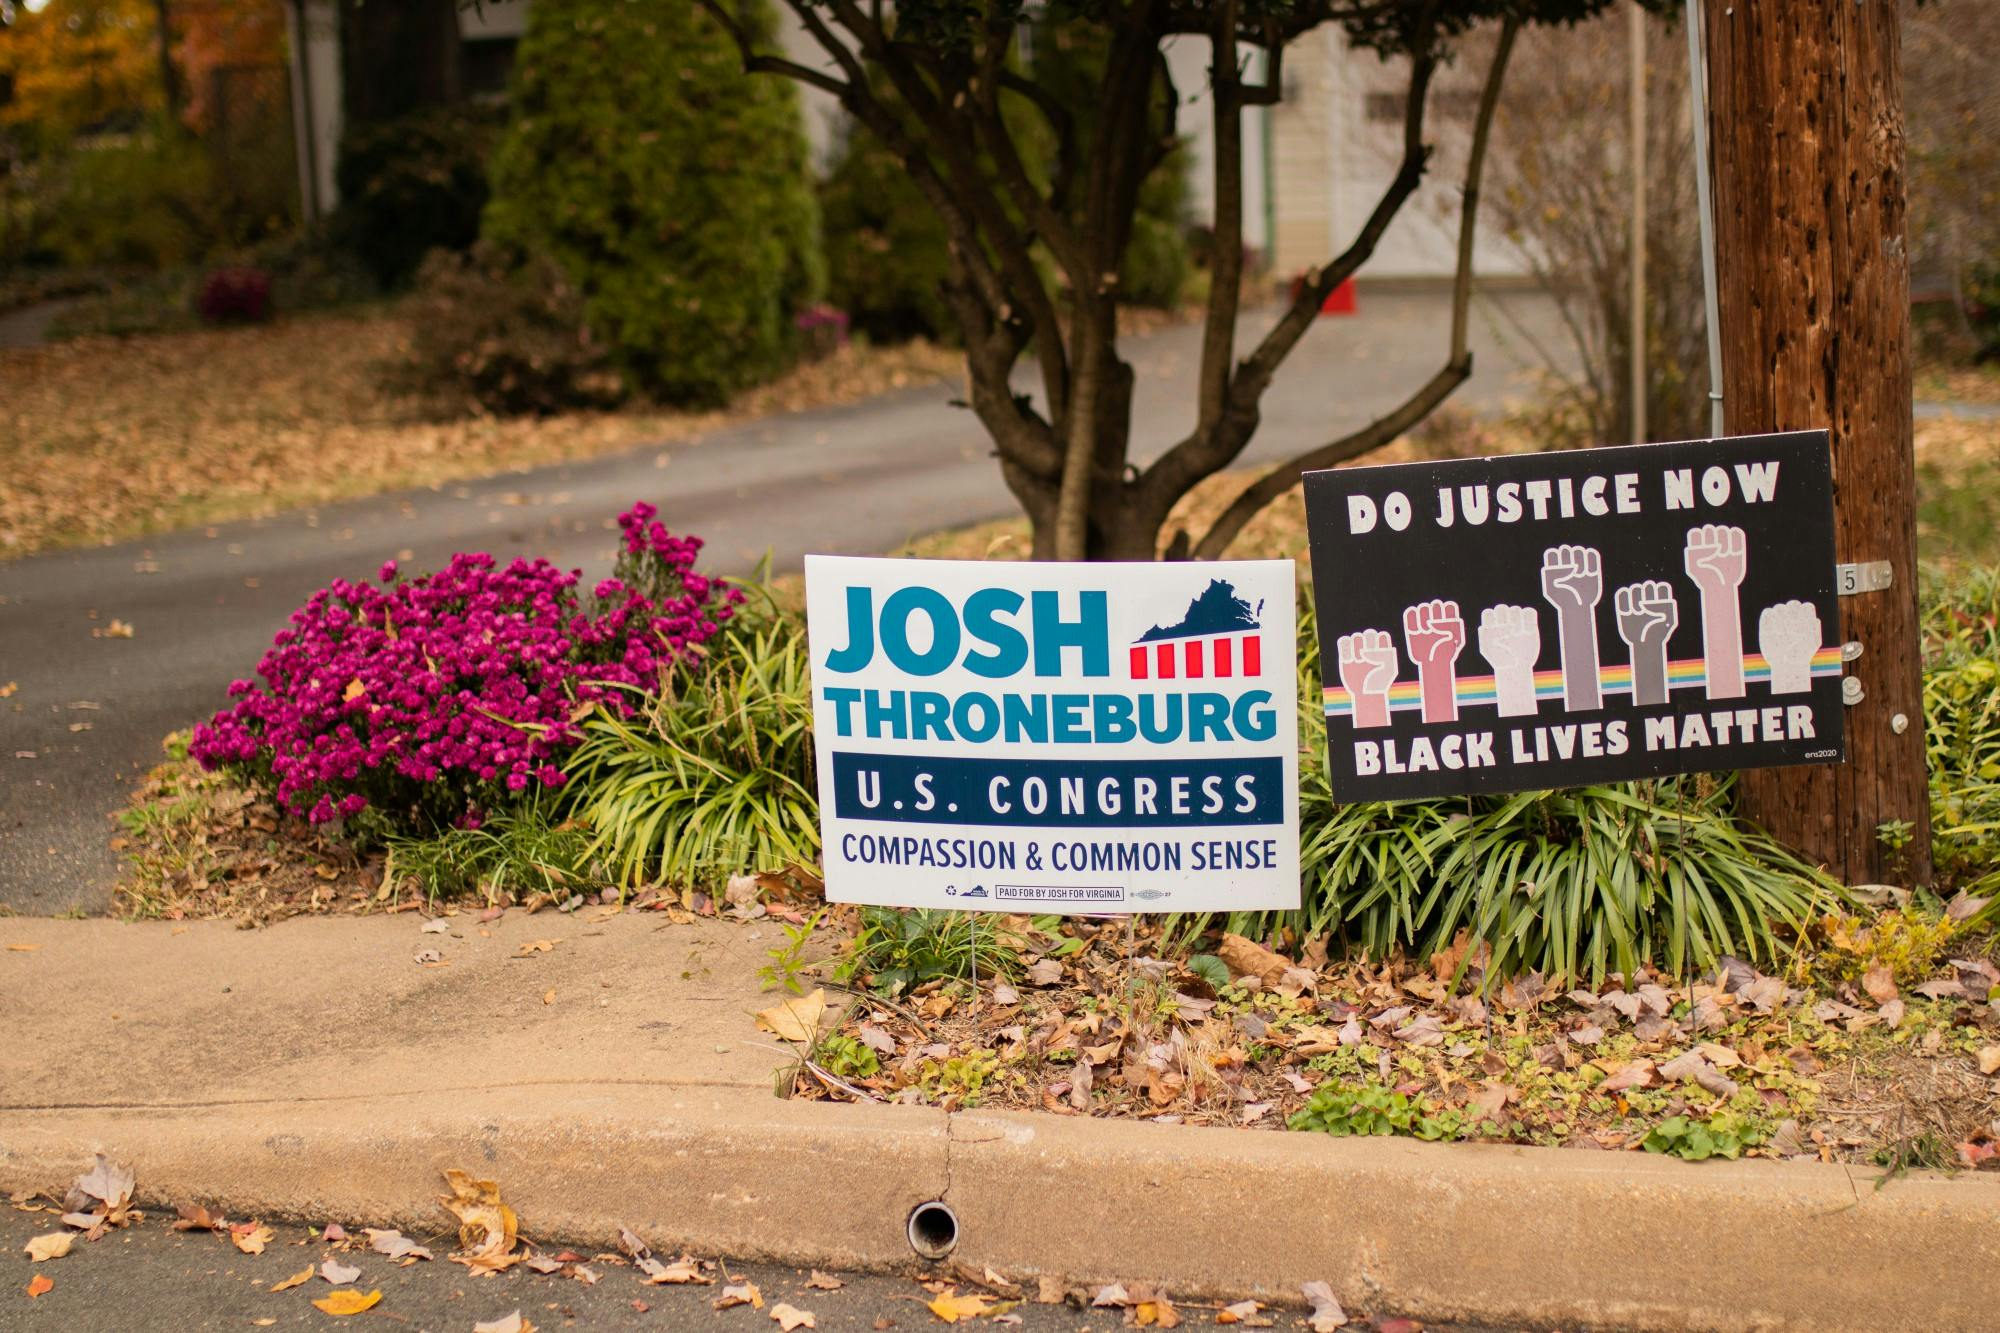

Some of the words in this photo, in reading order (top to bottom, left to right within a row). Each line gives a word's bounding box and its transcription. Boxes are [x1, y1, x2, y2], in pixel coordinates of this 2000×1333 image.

[1347, 491, 1412, 535] DO
[1435, 473, 1641, 528] JUSTICE
[1664, 461, 1780, 511] NOW
[1845, 570, 1855, 590] 5
[824, 586, 1110, 678] JOSH
[823, 686, 1277, 744] THRONEBURG
[1354, 732, 1496, 776] BLACK
[1511, 720, 1629, 764] LIVES
[1644, 705, 1816, 752] MATTER
[1804, 749, 1837, 759] ens2020
[857, 770, 958, 812] U.S.
[988, 774, 1257, 815] CONGRESS
[842, 832, 1016, 870] COMPASSION
[1025, 843, 1044, 871] &
[1051, 841, 1182, 872] COMMON
[1191, 839, 1278, 870] SENSE
[999, 887, 1018, 897] PAID
[1019, 888, 1035, 897] FOR
[1036, 888, 1047, 898] BY
[1047, 888, 1067, 898] JOSH
[1069, 889, 1084, 898] FOR
[1085, 889, 1121, 899] VIRGINIA
